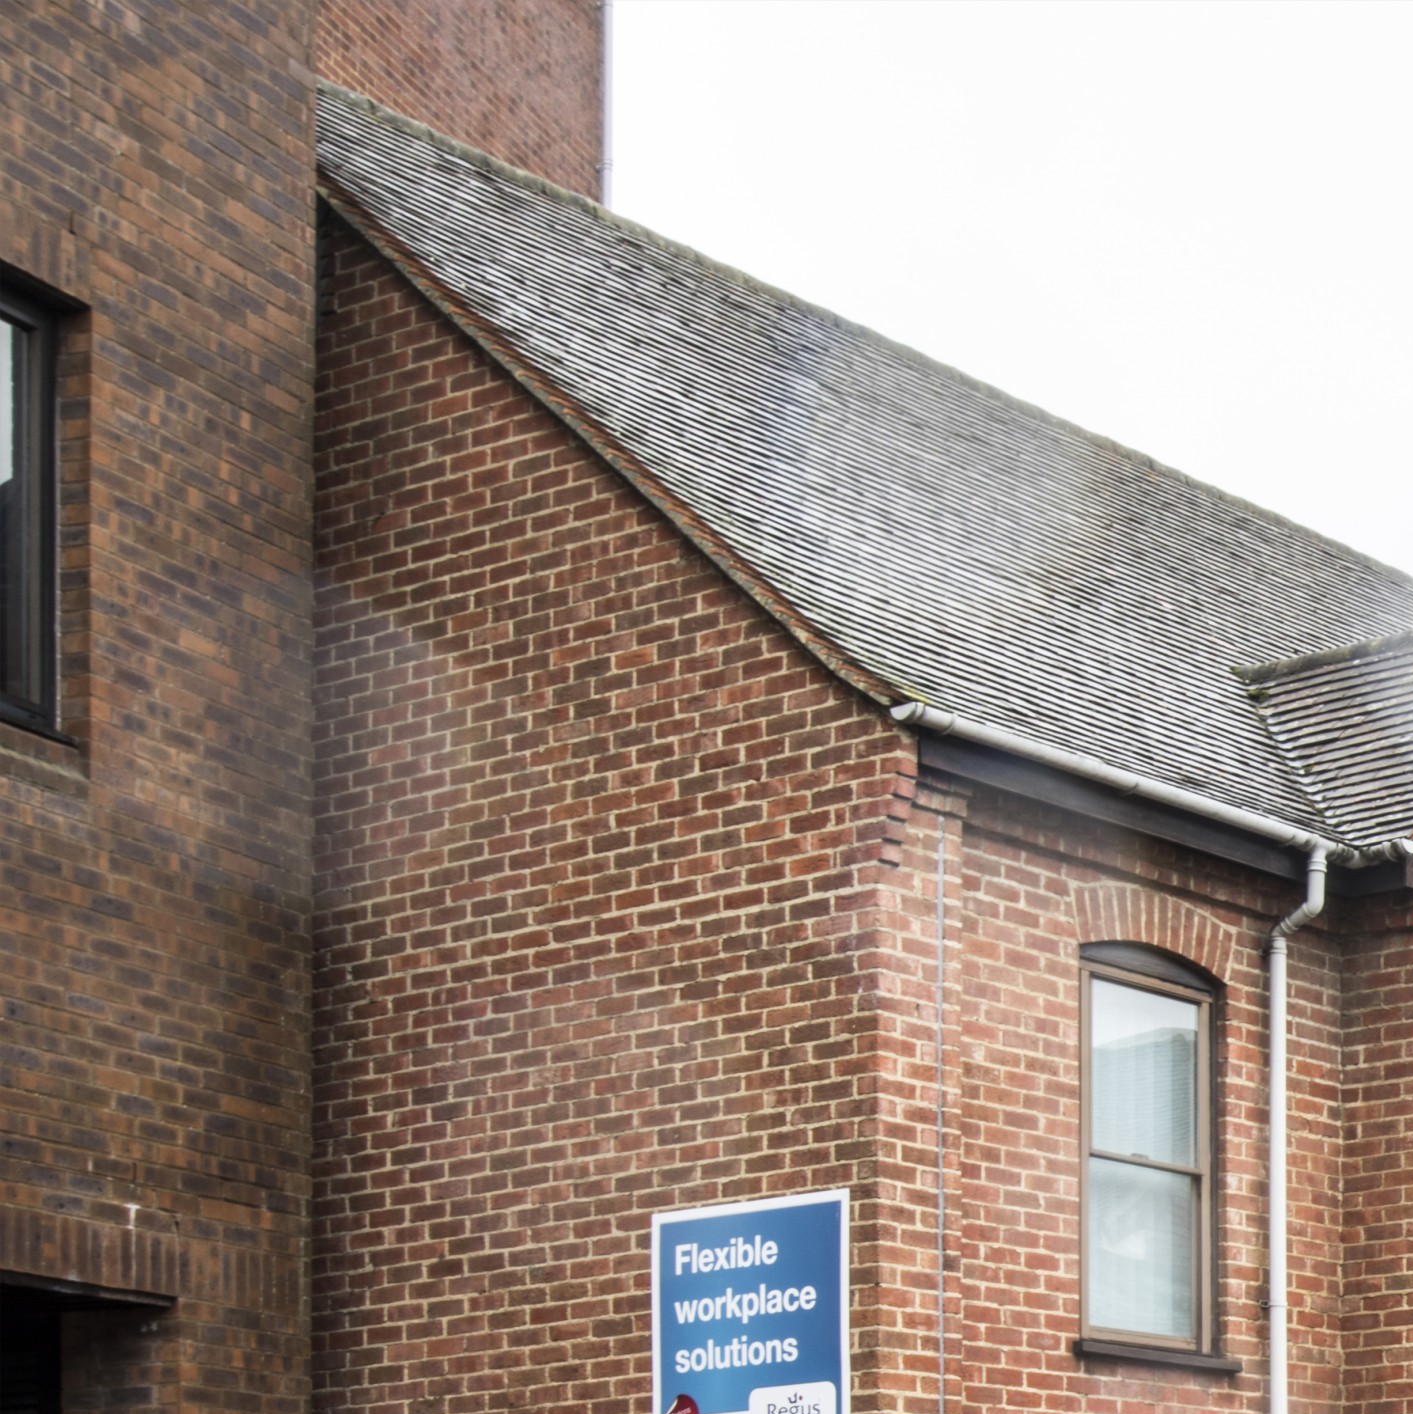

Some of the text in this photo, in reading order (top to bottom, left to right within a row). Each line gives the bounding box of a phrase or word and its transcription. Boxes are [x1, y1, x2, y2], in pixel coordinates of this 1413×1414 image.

[675, 1235, 778, 1275] Flexible
[674, 1283, 817, 1324] workplace
[675, 1335, 798, 1373] solutions
